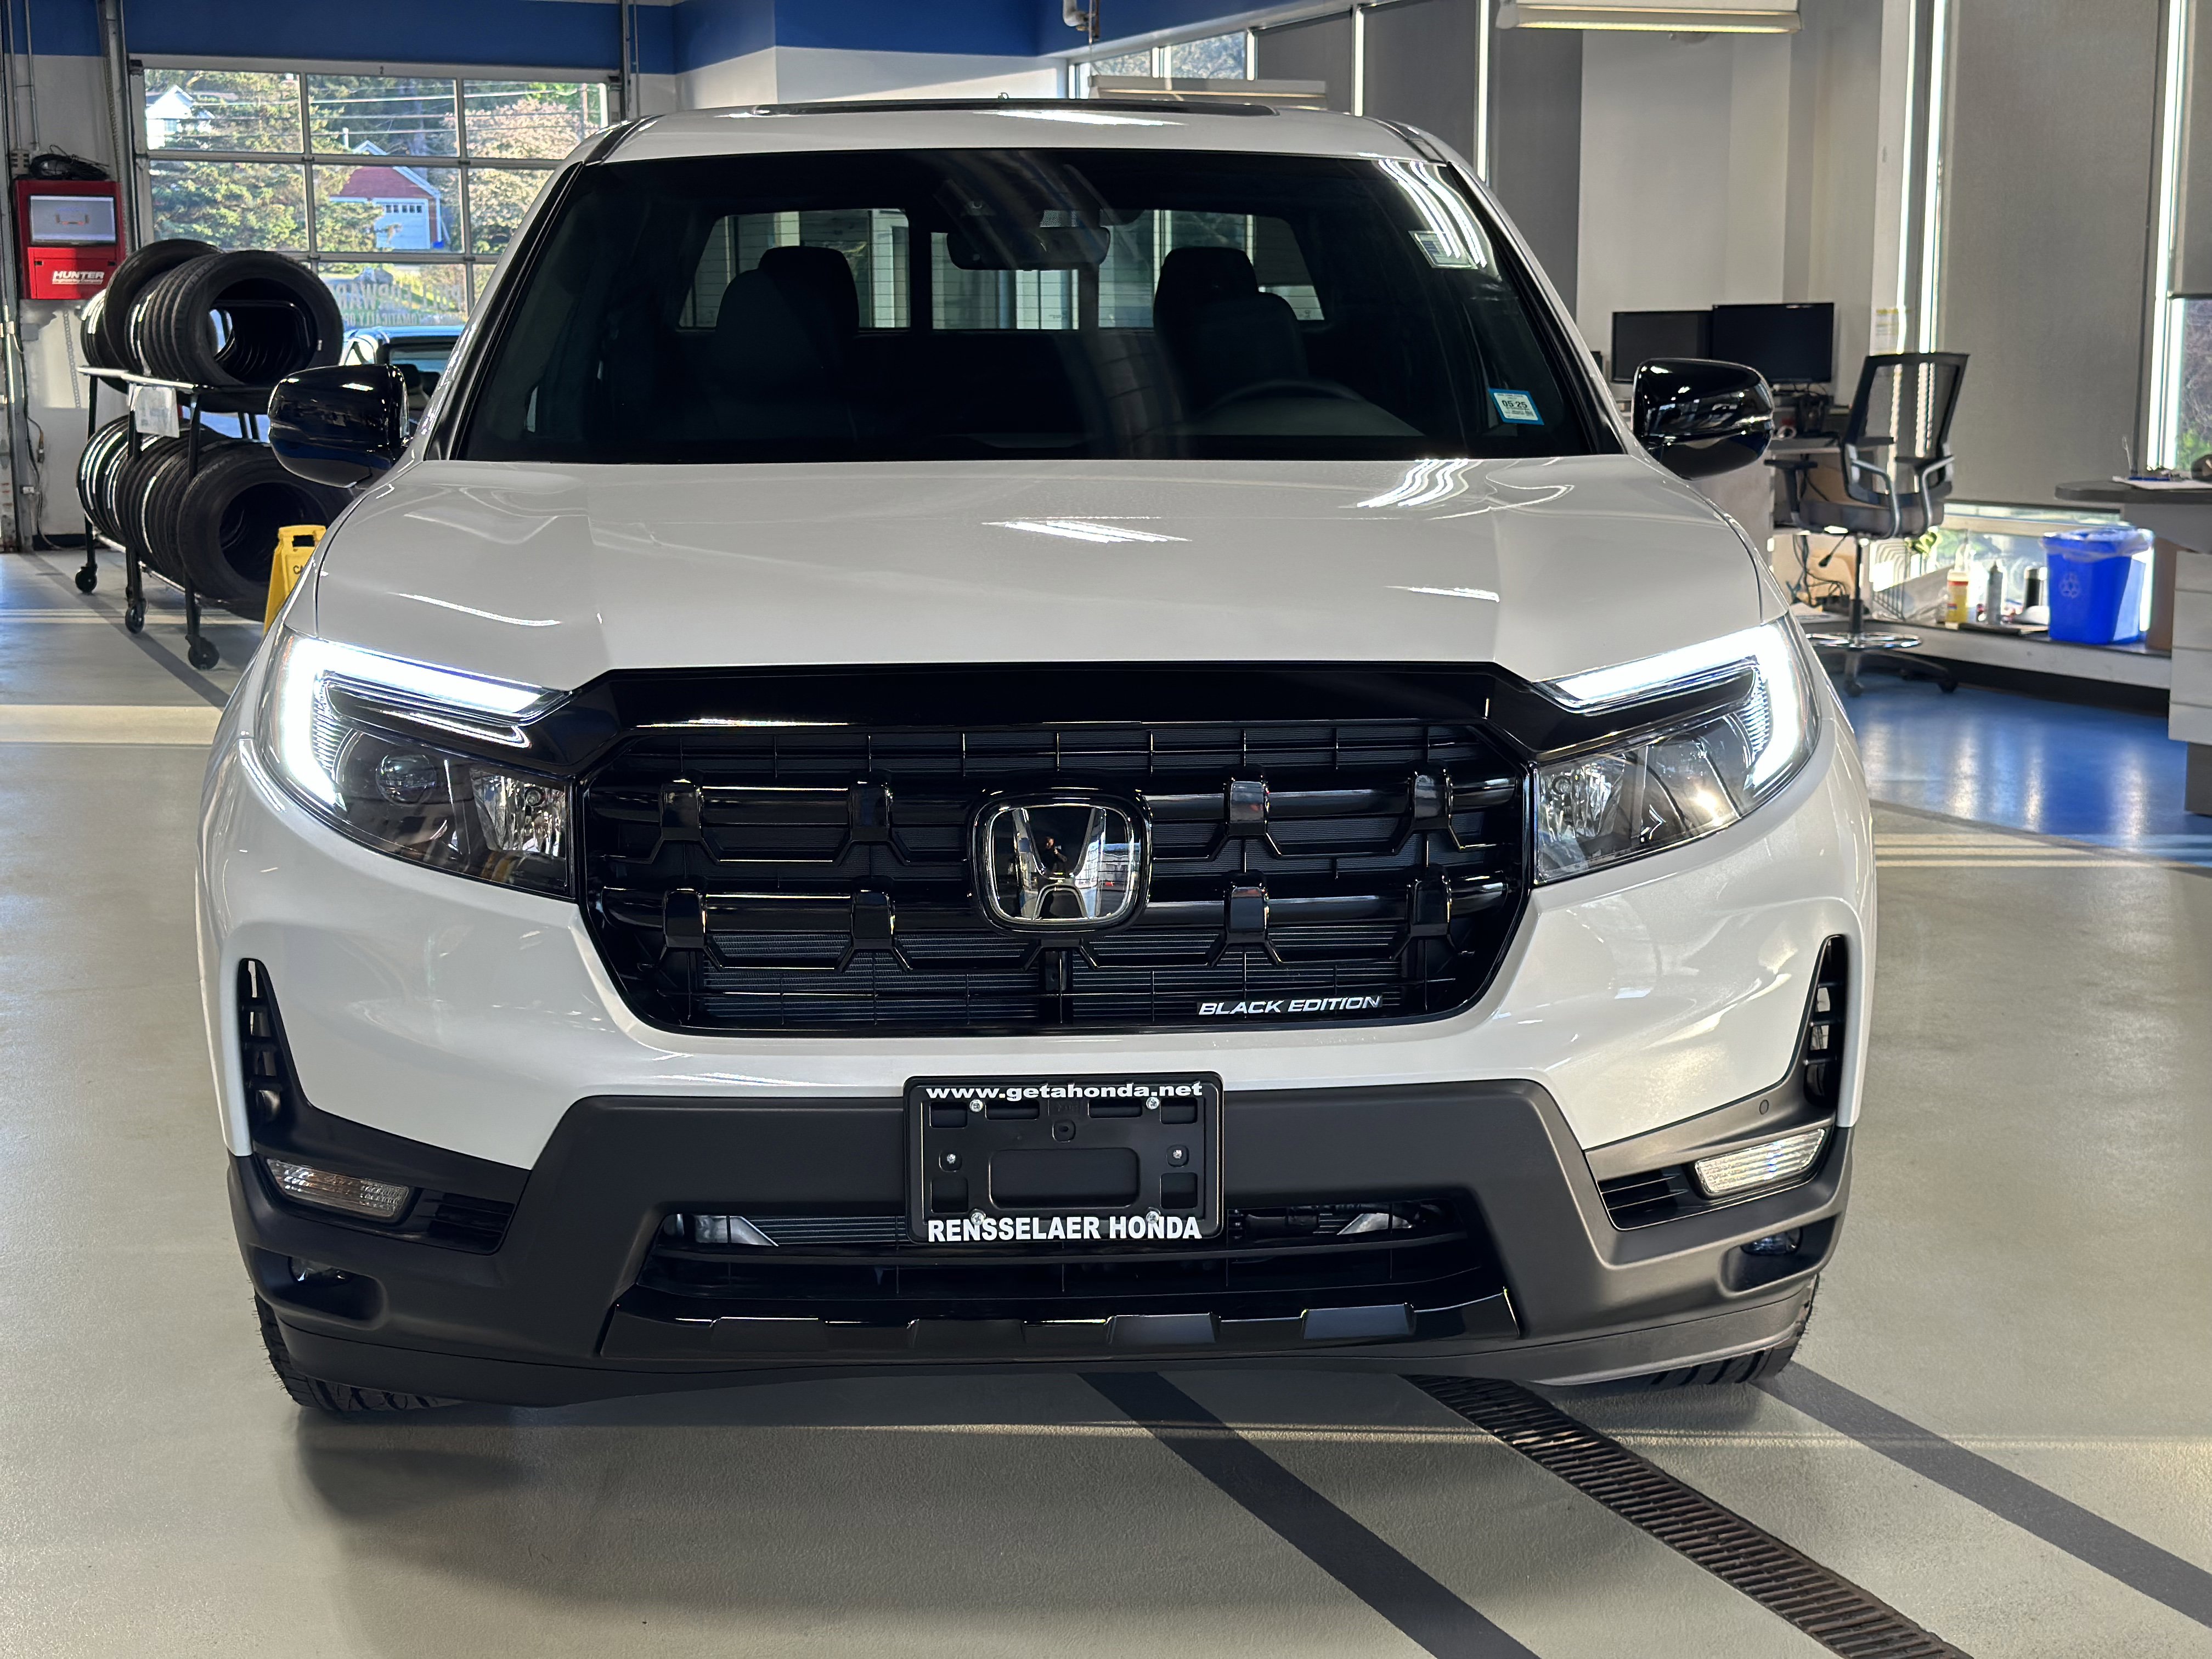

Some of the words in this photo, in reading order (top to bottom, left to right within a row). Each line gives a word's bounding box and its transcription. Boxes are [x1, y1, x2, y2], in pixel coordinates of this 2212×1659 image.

[53, 270, 104, 279] HUNTER
[1198, 1000, 1285, 1015] BLACK
[1288, 996, 1381, 1012] EDITION
[926, 1082, 1203, 1102] www.getahonda.net
[928, 1216, 1101, 1242] RENSSELAER
[1109, 1216, 1202, 1239] HONDA
